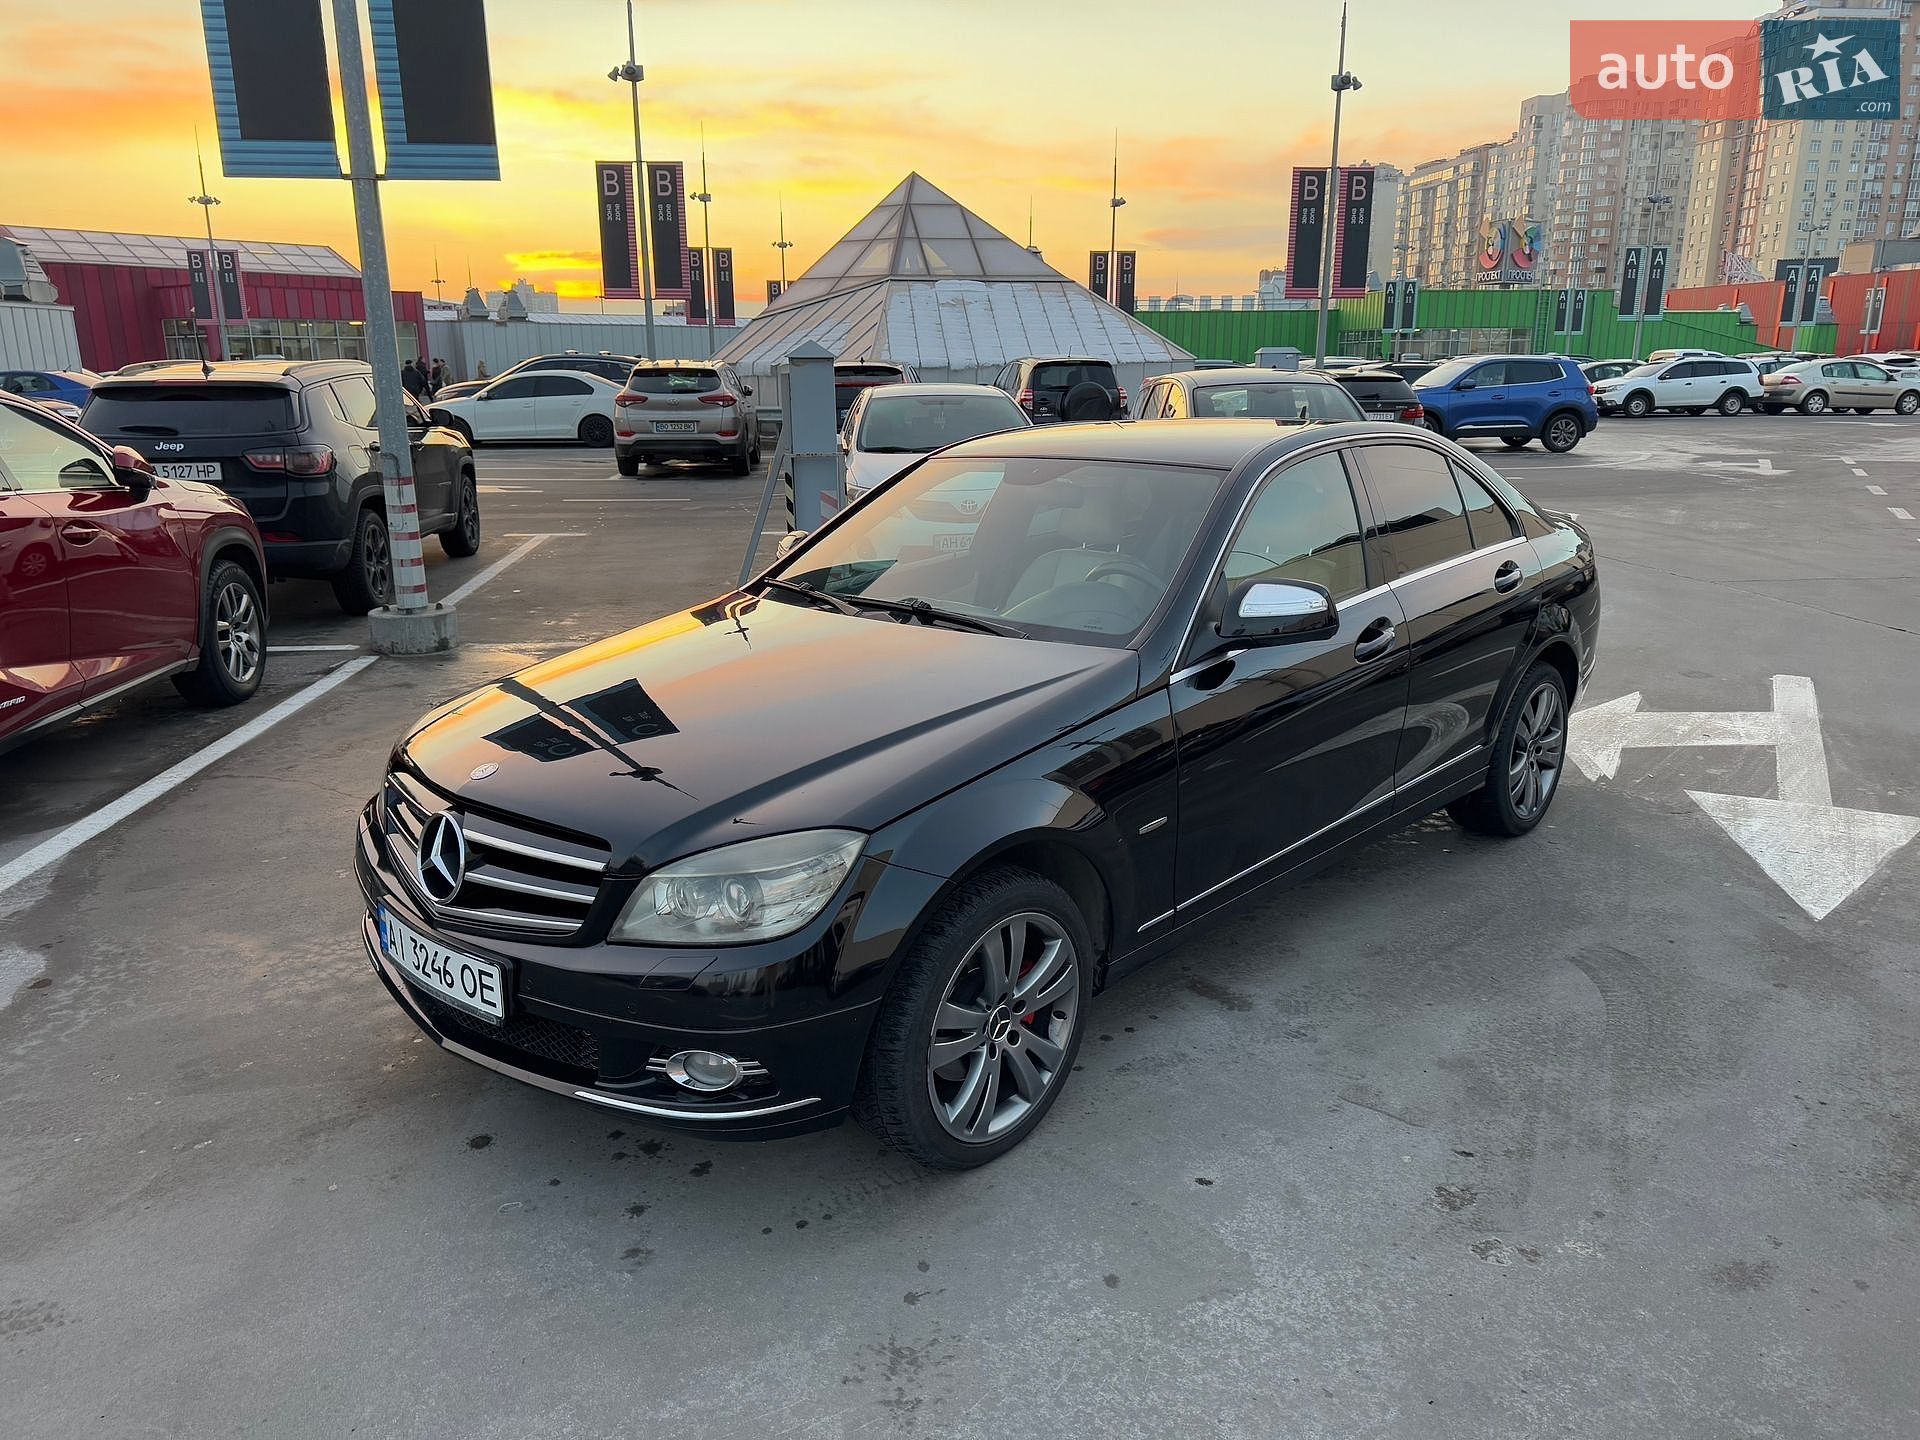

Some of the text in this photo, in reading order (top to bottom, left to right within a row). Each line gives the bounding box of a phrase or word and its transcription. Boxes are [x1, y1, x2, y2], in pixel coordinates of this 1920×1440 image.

[602, 169, 620, 196] B
[655, 169, 673, 196] B
[1303, 175, 1319, 201] B
[1351, 175, 1367, 201] B
[191, 253, 202, 269] B
[222, 254, 233, 269] B
[690, 251, 700, 267] B
[719, 252, 729, 268] B
[1096, 255, 1105, 270] B
[1123, 255, 1132, 270] B
[1627, 250, 1637, 265] A
[1654, 250, 1664, 265] A
[1787, 269, 1796, 282] A
[1809, 269, 1818, 282] A
[1386, 283, 1395, 295] A
[1406, 283, 1415, 295] A
[154, 441, 185, 452] Jeep
[162, 465, 193, 479] 5127
[195, 464, 216, 478] HP
[389, 919, 497, 1008] AI 3246 OE
